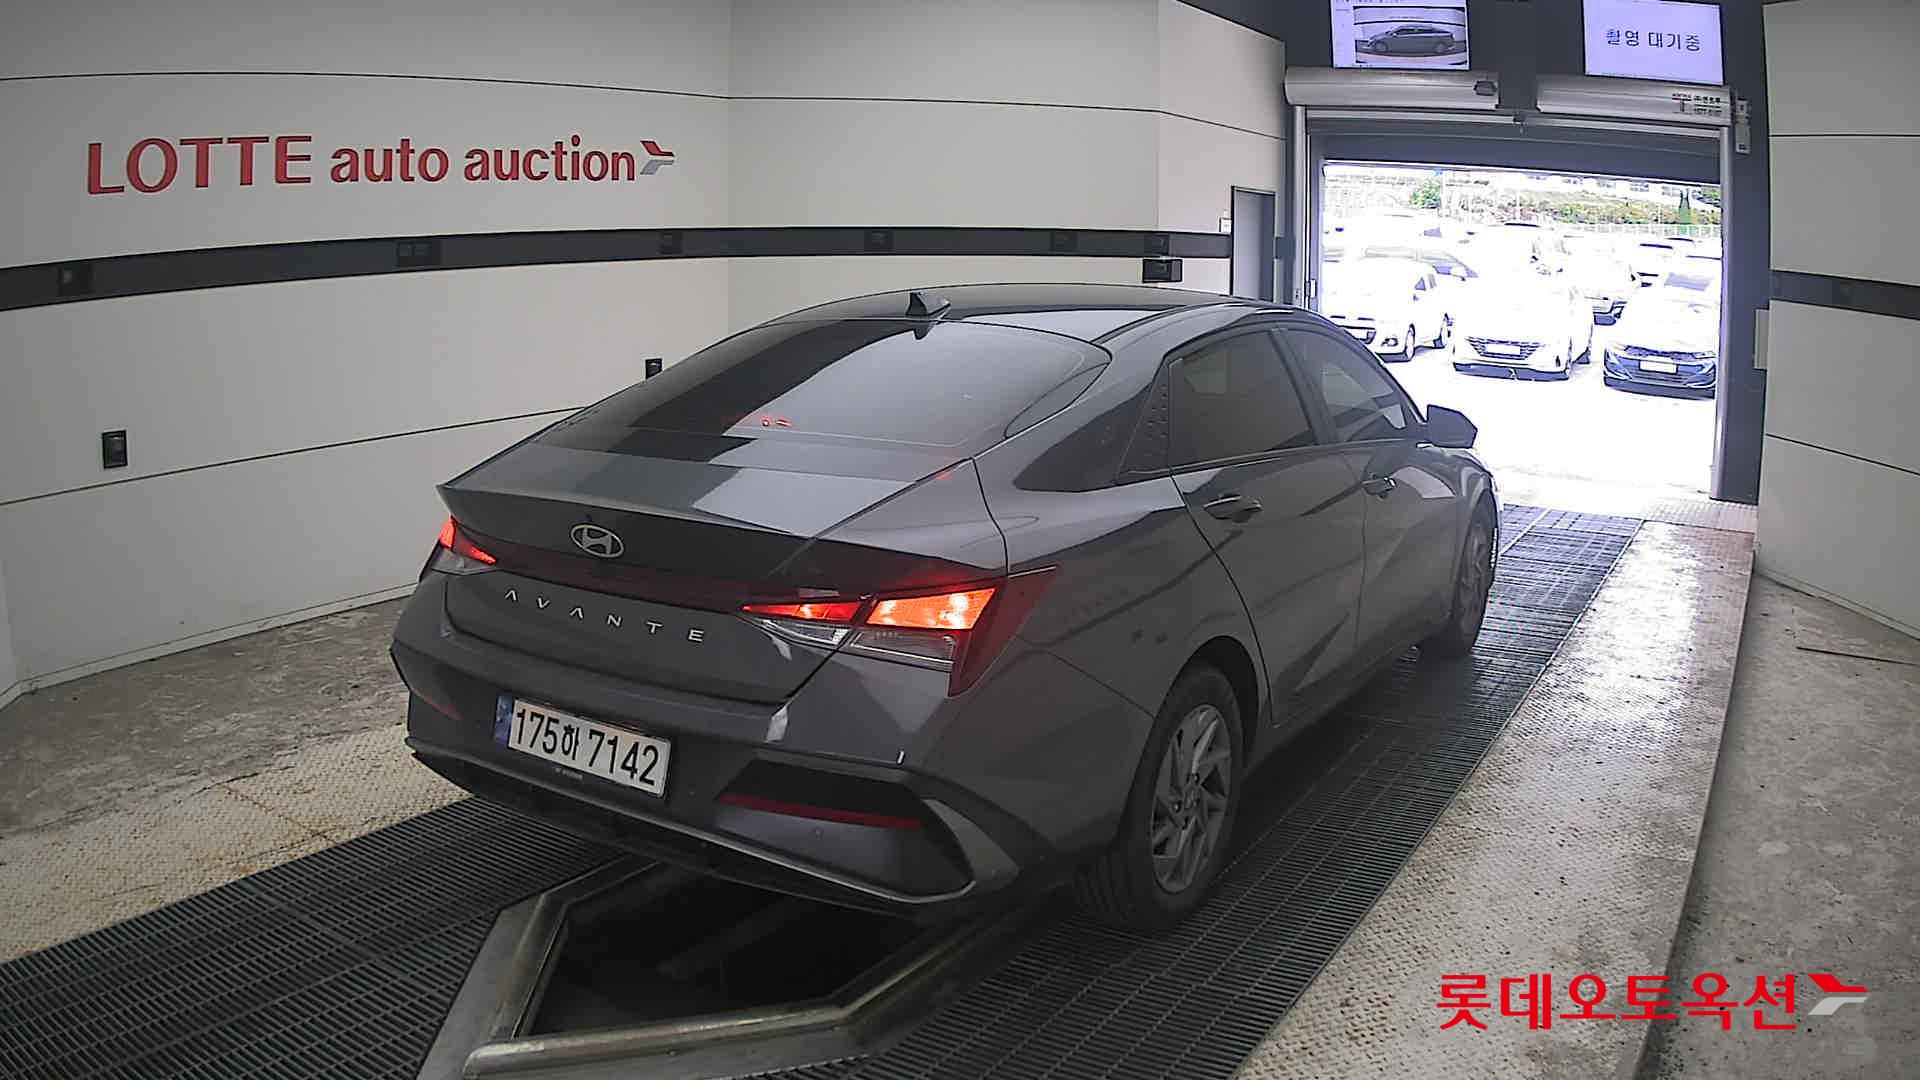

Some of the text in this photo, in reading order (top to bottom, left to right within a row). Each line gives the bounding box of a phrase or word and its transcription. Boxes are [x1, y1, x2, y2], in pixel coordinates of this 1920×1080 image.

[87, 135, 636, 195] LOTTE auto auction
[504, 589, 706, 643] AVANTE
[516, 708, 660, 786] 175하 7142
